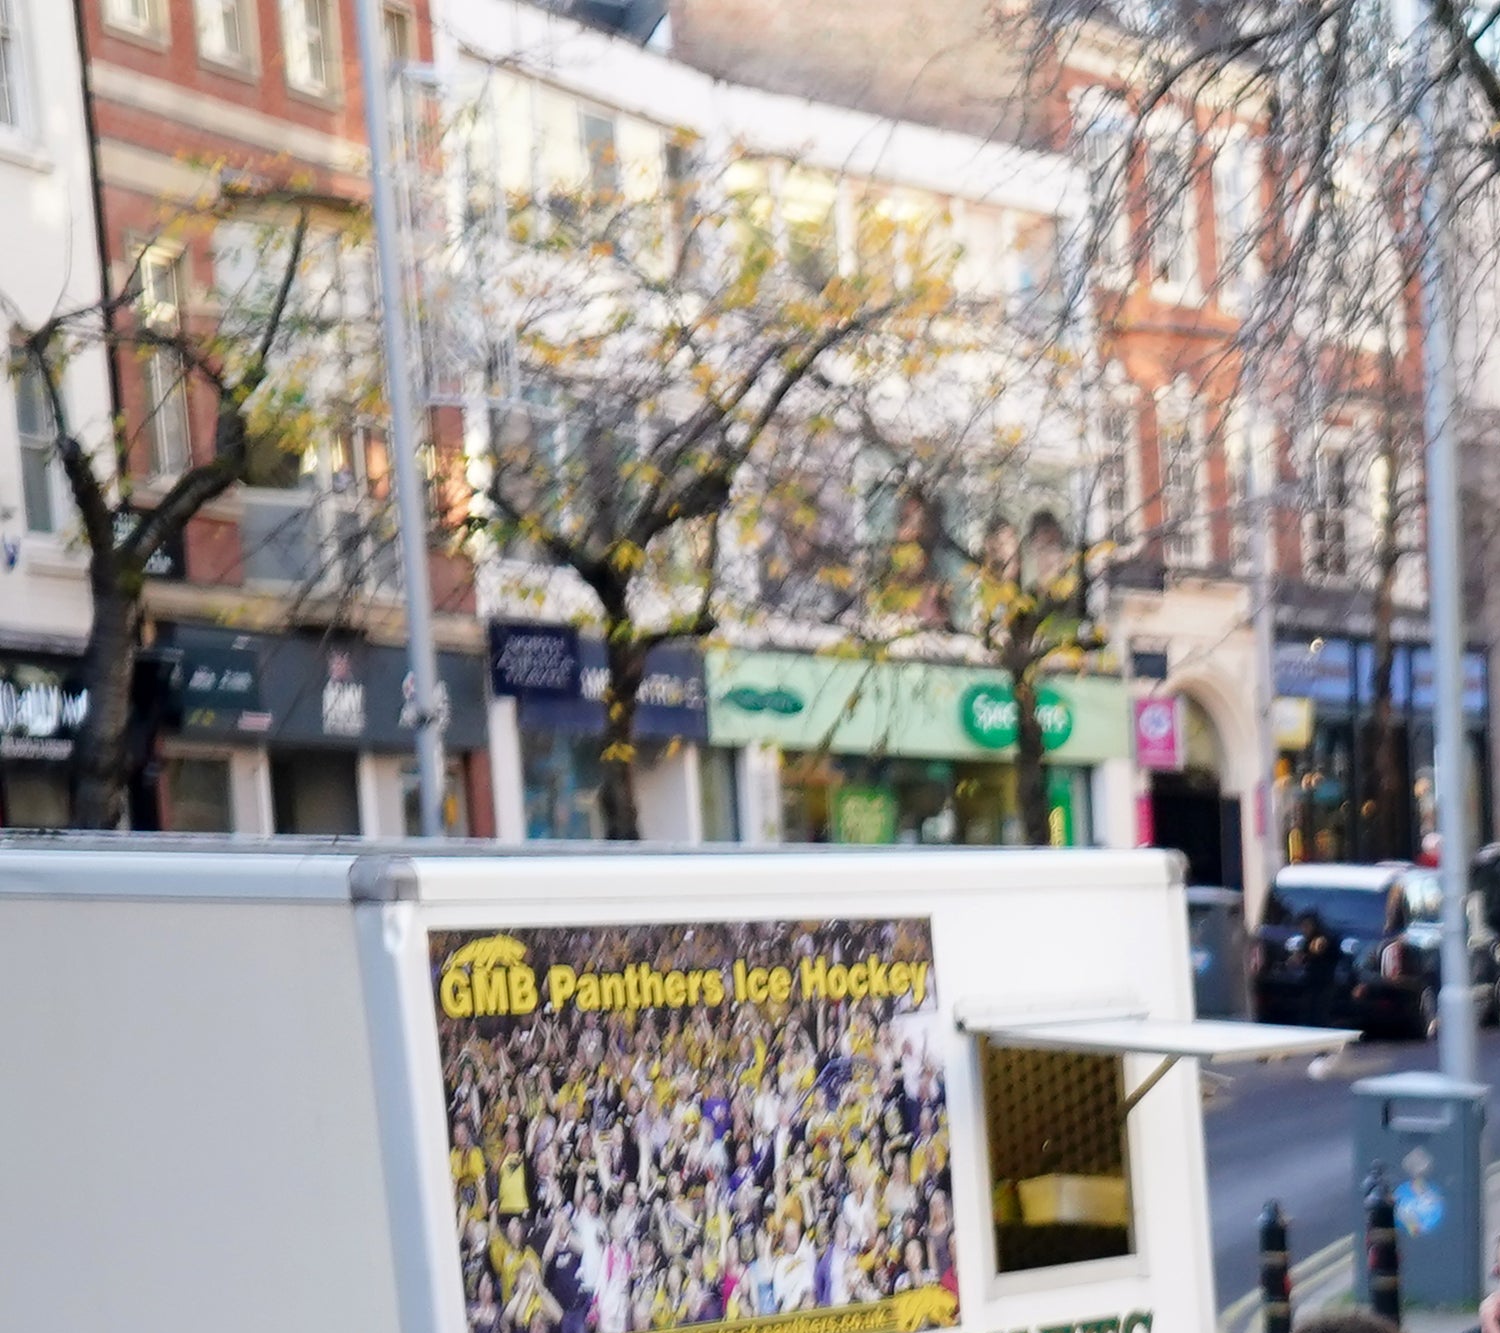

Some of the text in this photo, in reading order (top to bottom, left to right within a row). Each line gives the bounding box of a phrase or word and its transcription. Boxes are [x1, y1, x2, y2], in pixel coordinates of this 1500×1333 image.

[440, 953, 929, 1019] GMB Panthers Ice Hockey
